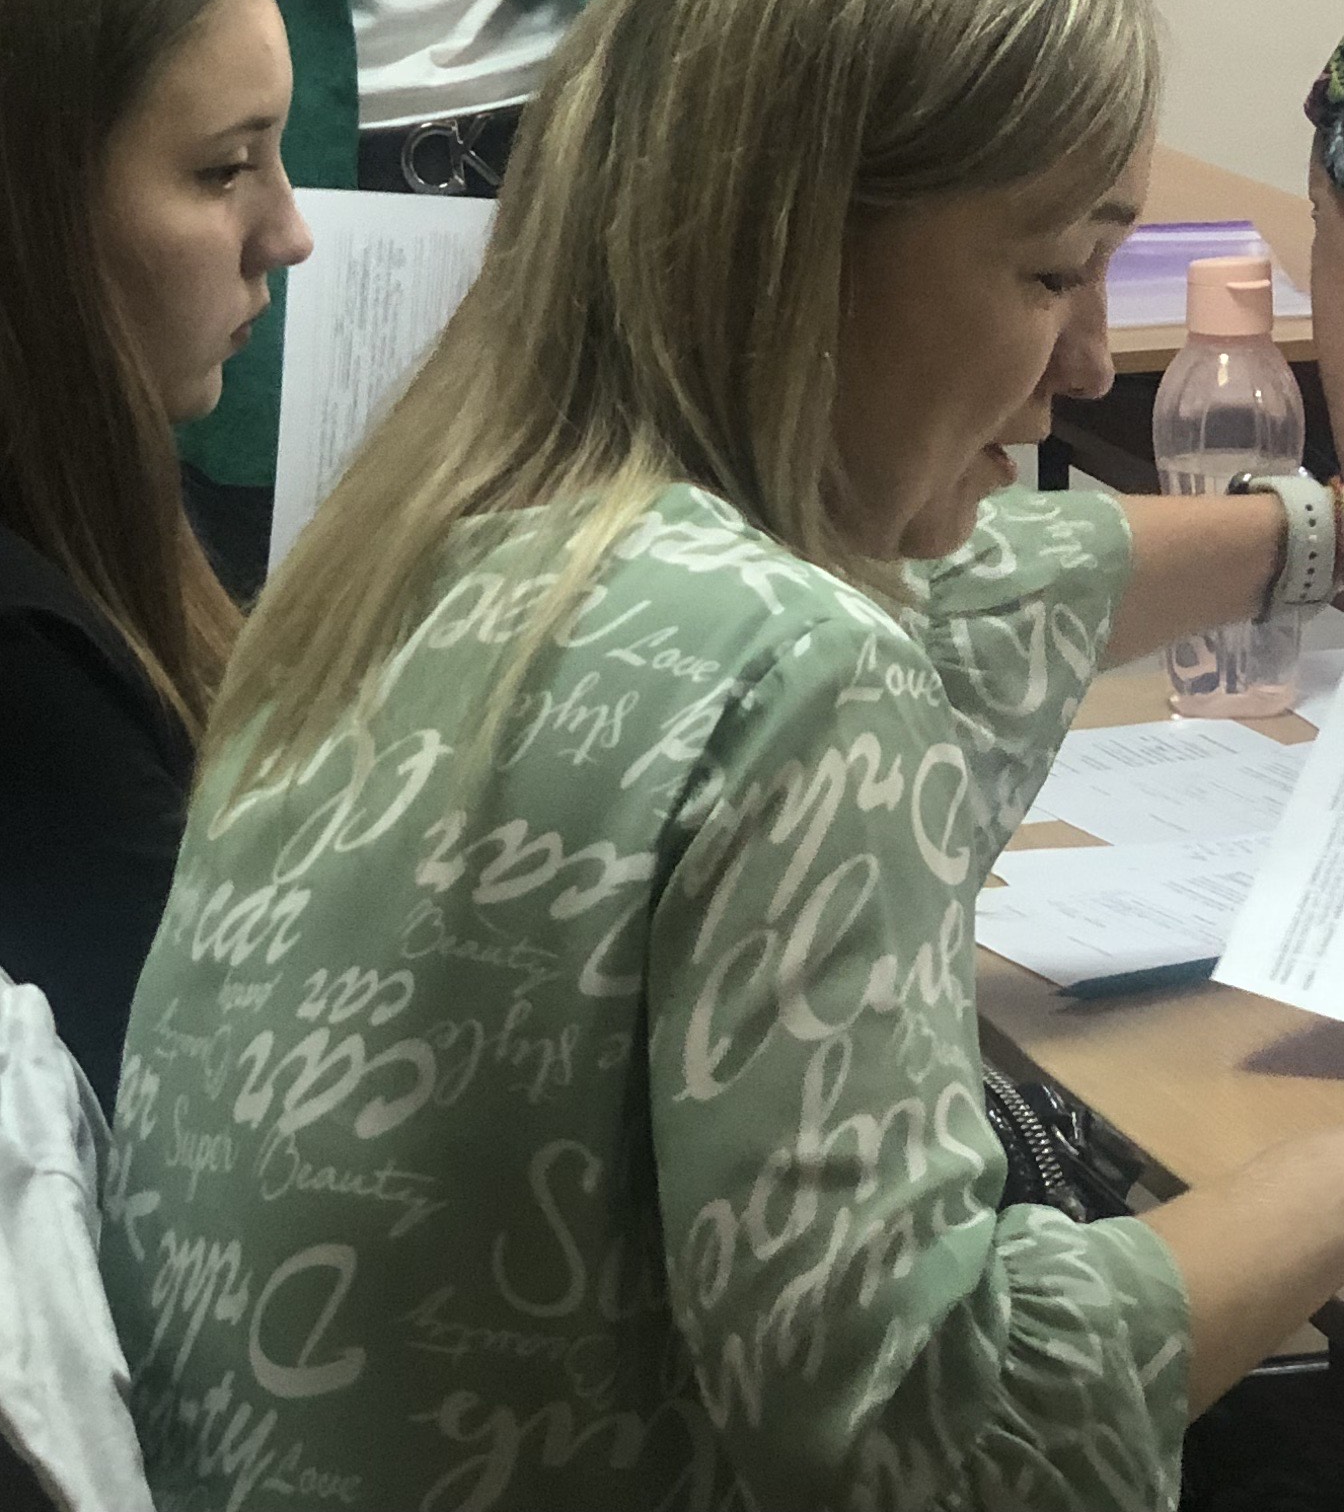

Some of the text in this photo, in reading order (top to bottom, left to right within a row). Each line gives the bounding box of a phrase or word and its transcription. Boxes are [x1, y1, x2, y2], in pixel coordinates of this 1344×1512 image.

[605, 624, 722, 686] Love
[835, 632, 945, 708] Love
[164, 1092, 238, 1203] Super
[258, 1125, 449, 1240] Beauty
